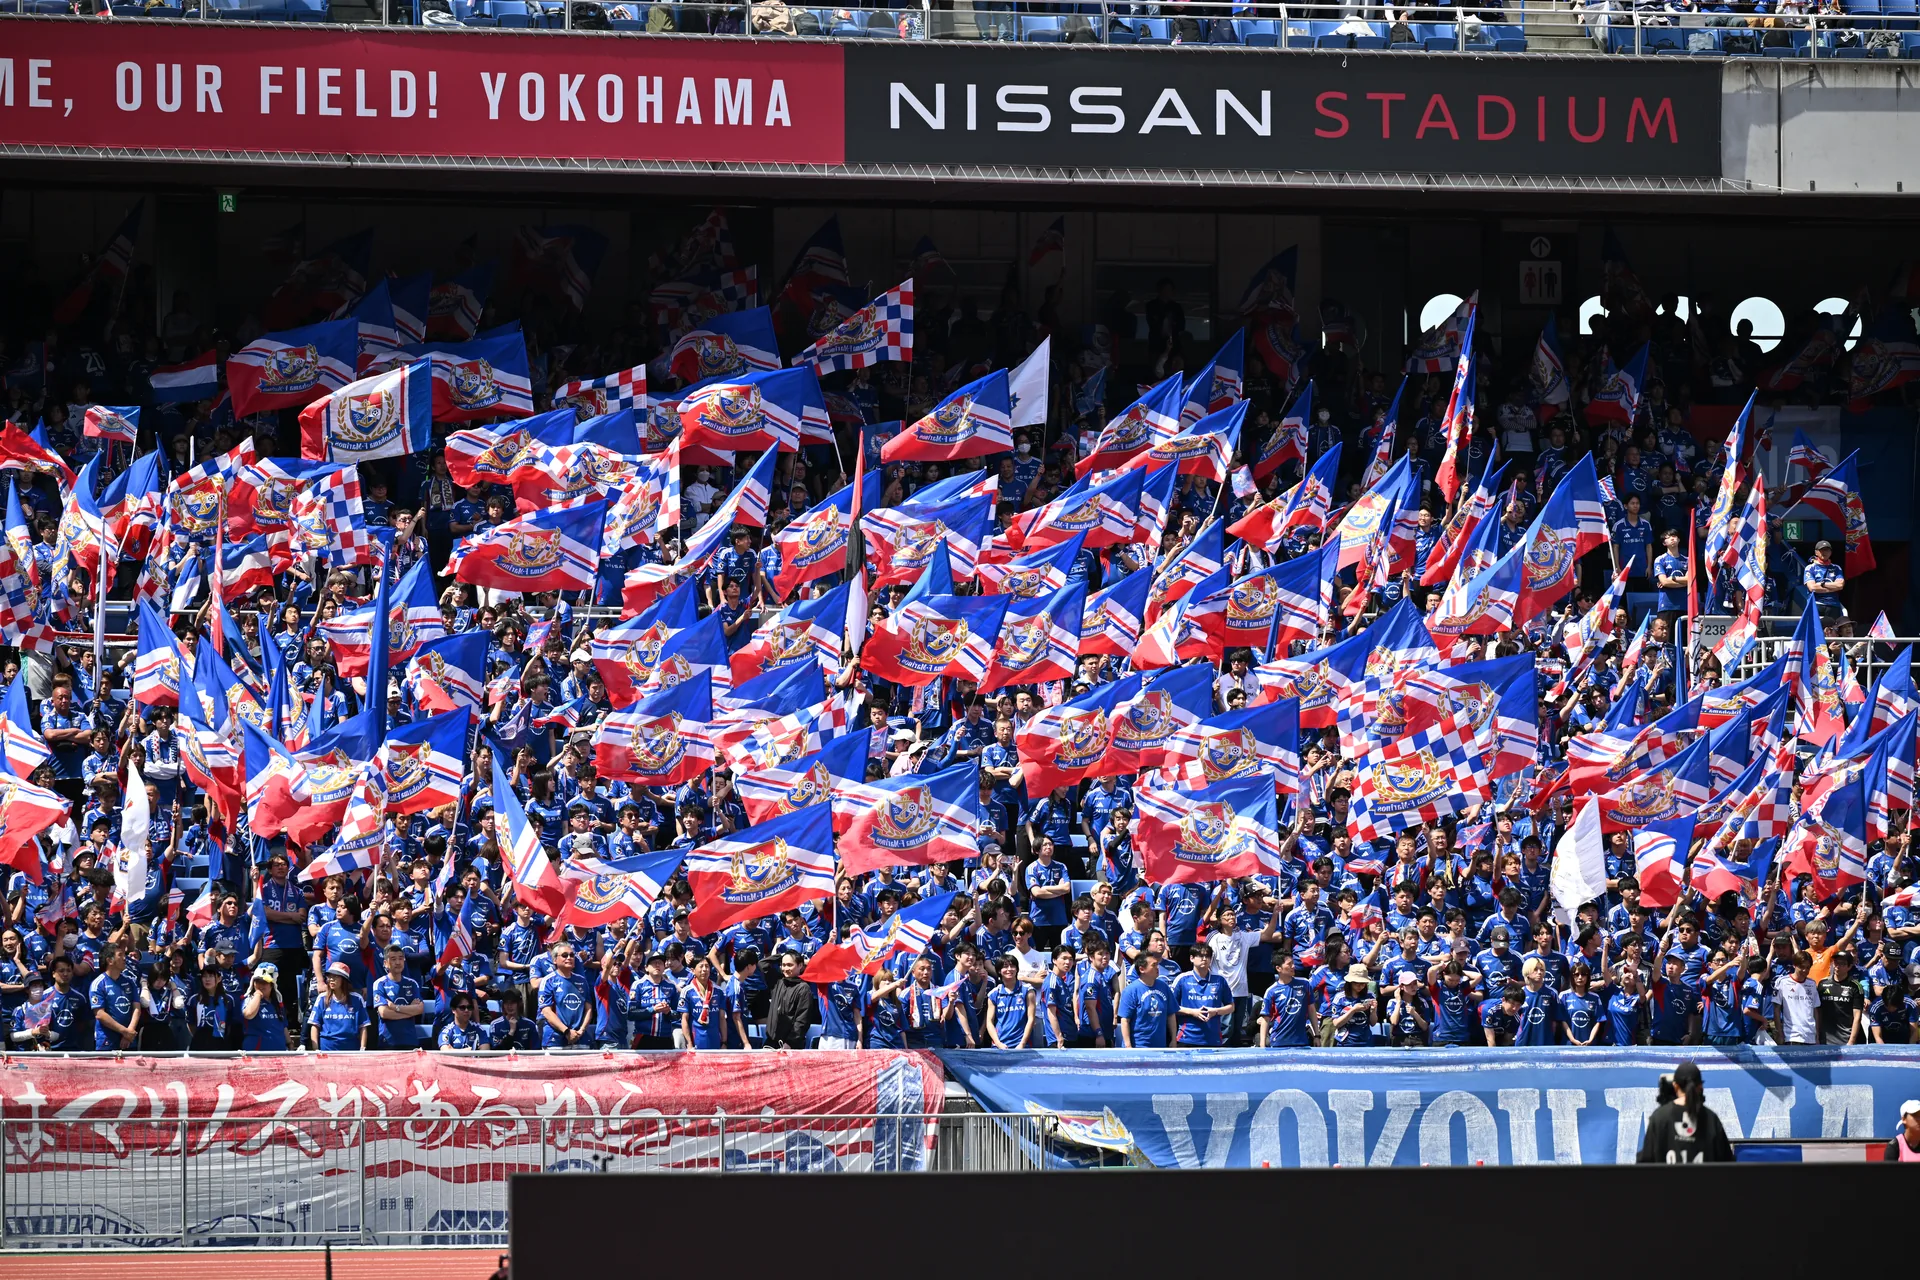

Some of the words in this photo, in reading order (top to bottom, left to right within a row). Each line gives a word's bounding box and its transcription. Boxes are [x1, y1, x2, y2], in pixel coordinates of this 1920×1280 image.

[116, 61, 224, 113] OUR
[260, 66, 438, 119] FIELD!
[481, 71, 792, 127] YOKOHAMA
[889, 82, 1272, 137] NISSAN
[1314, 91, 1678, 143] STADIUM
[1705, 625, 1727, 637] 238
[1188, 994, 1218, 1002] NISSAN
[323, 1013, 355, 1021] NISSAN
